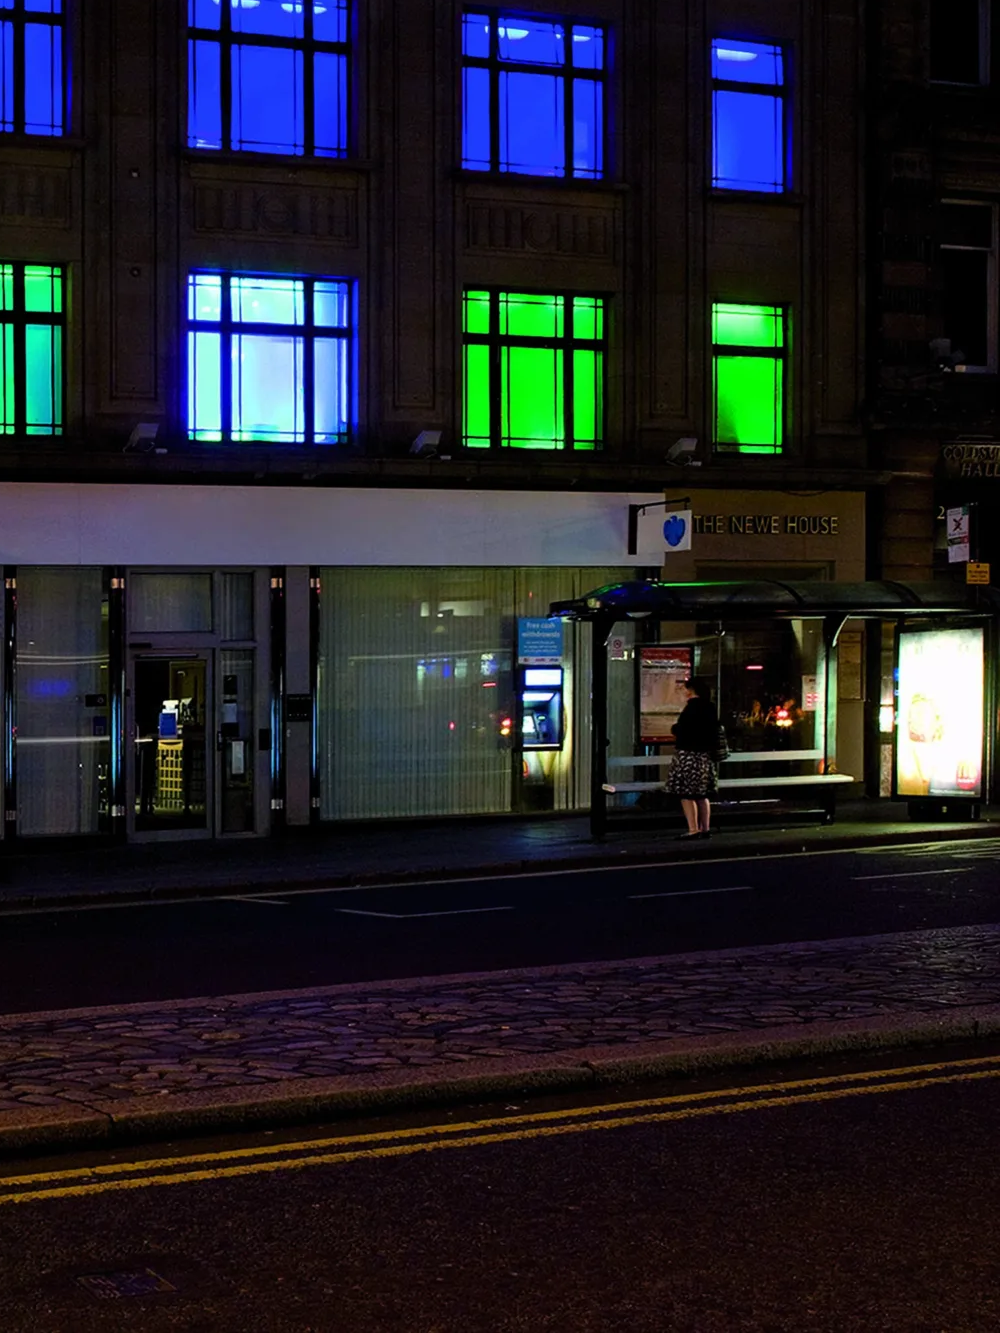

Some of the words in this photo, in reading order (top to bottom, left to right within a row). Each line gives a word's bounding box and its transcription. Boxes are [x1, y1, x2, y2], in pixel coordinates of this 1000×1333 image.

[936, 505, 945, 520] 2
[693, 515, 724, 534] THE
[731, 515, 780, 534] NEWE
[787, 515, 839, 534] HOUSE
